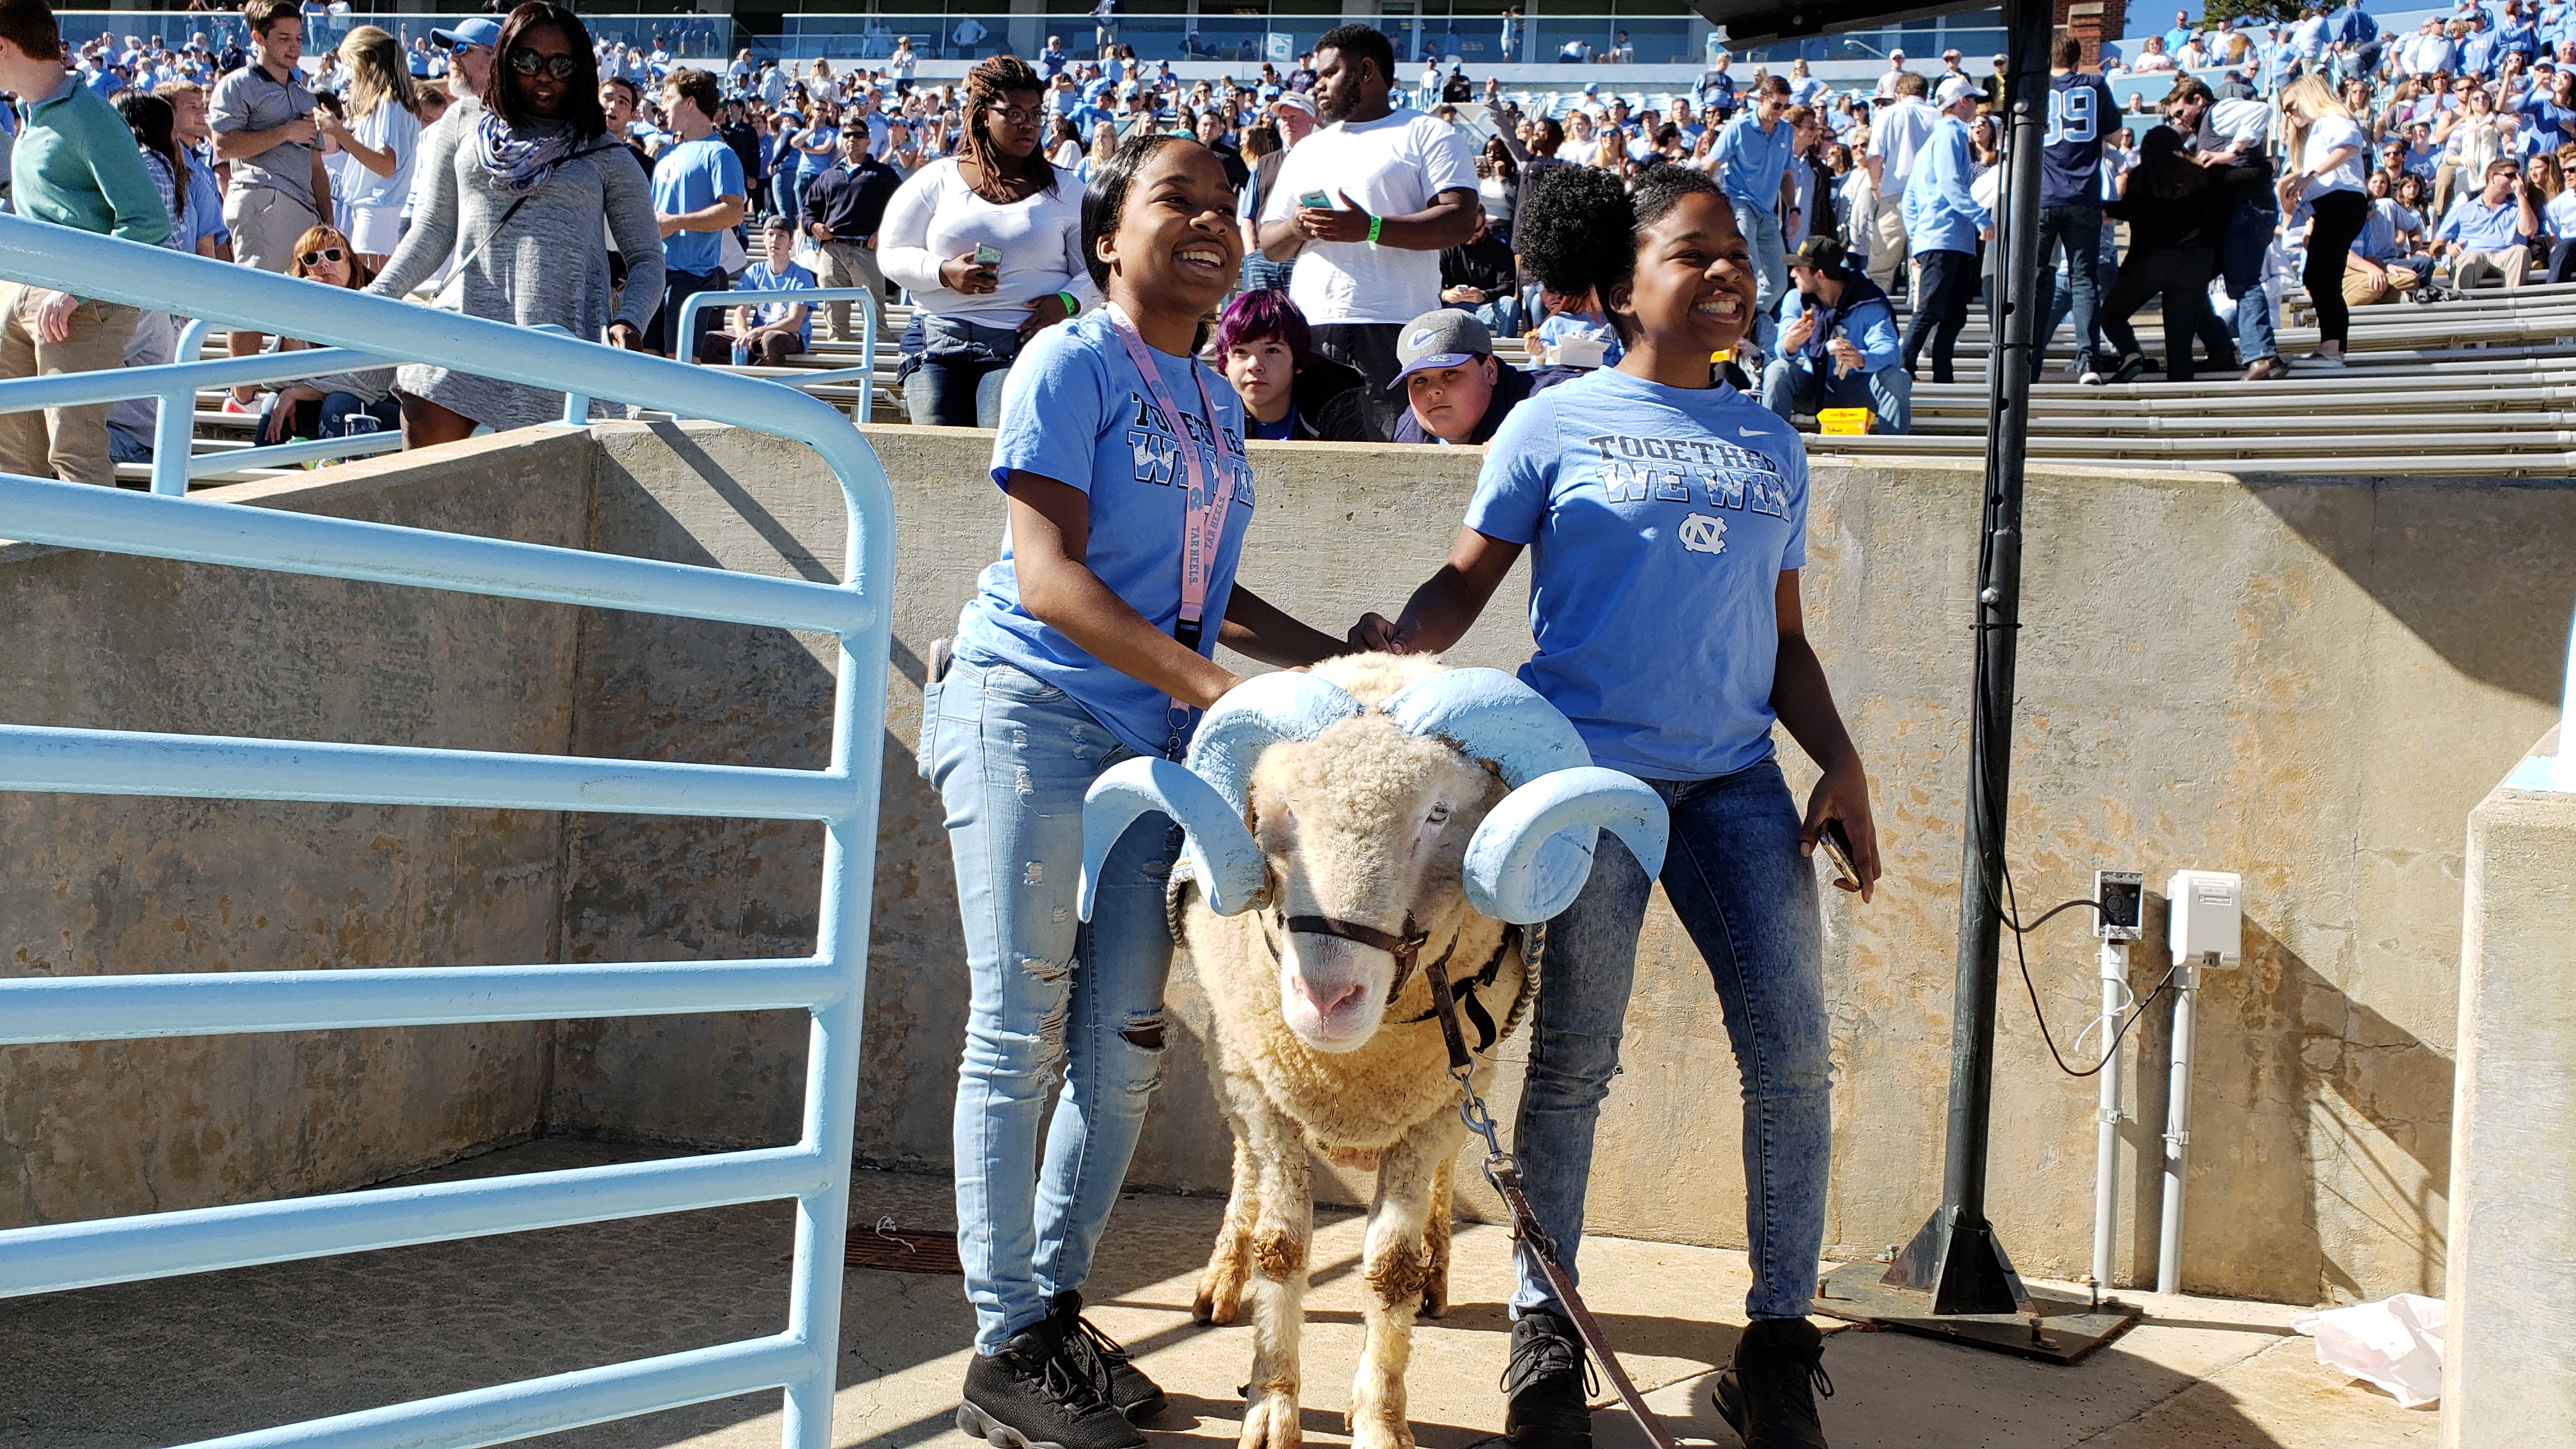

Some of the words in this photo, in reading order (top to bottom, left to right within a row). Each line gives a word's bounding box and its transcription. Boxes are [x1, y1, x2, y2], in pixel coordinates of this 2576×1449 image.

[1596, 461, 1690, 503] WE
[1210, 496, 1226, 530] HEELS
[1190, 526, 1200, 548] TAR
[1205, 530, 1216, 549] TAR
[1189, 549, 1200, 585] HEELS
